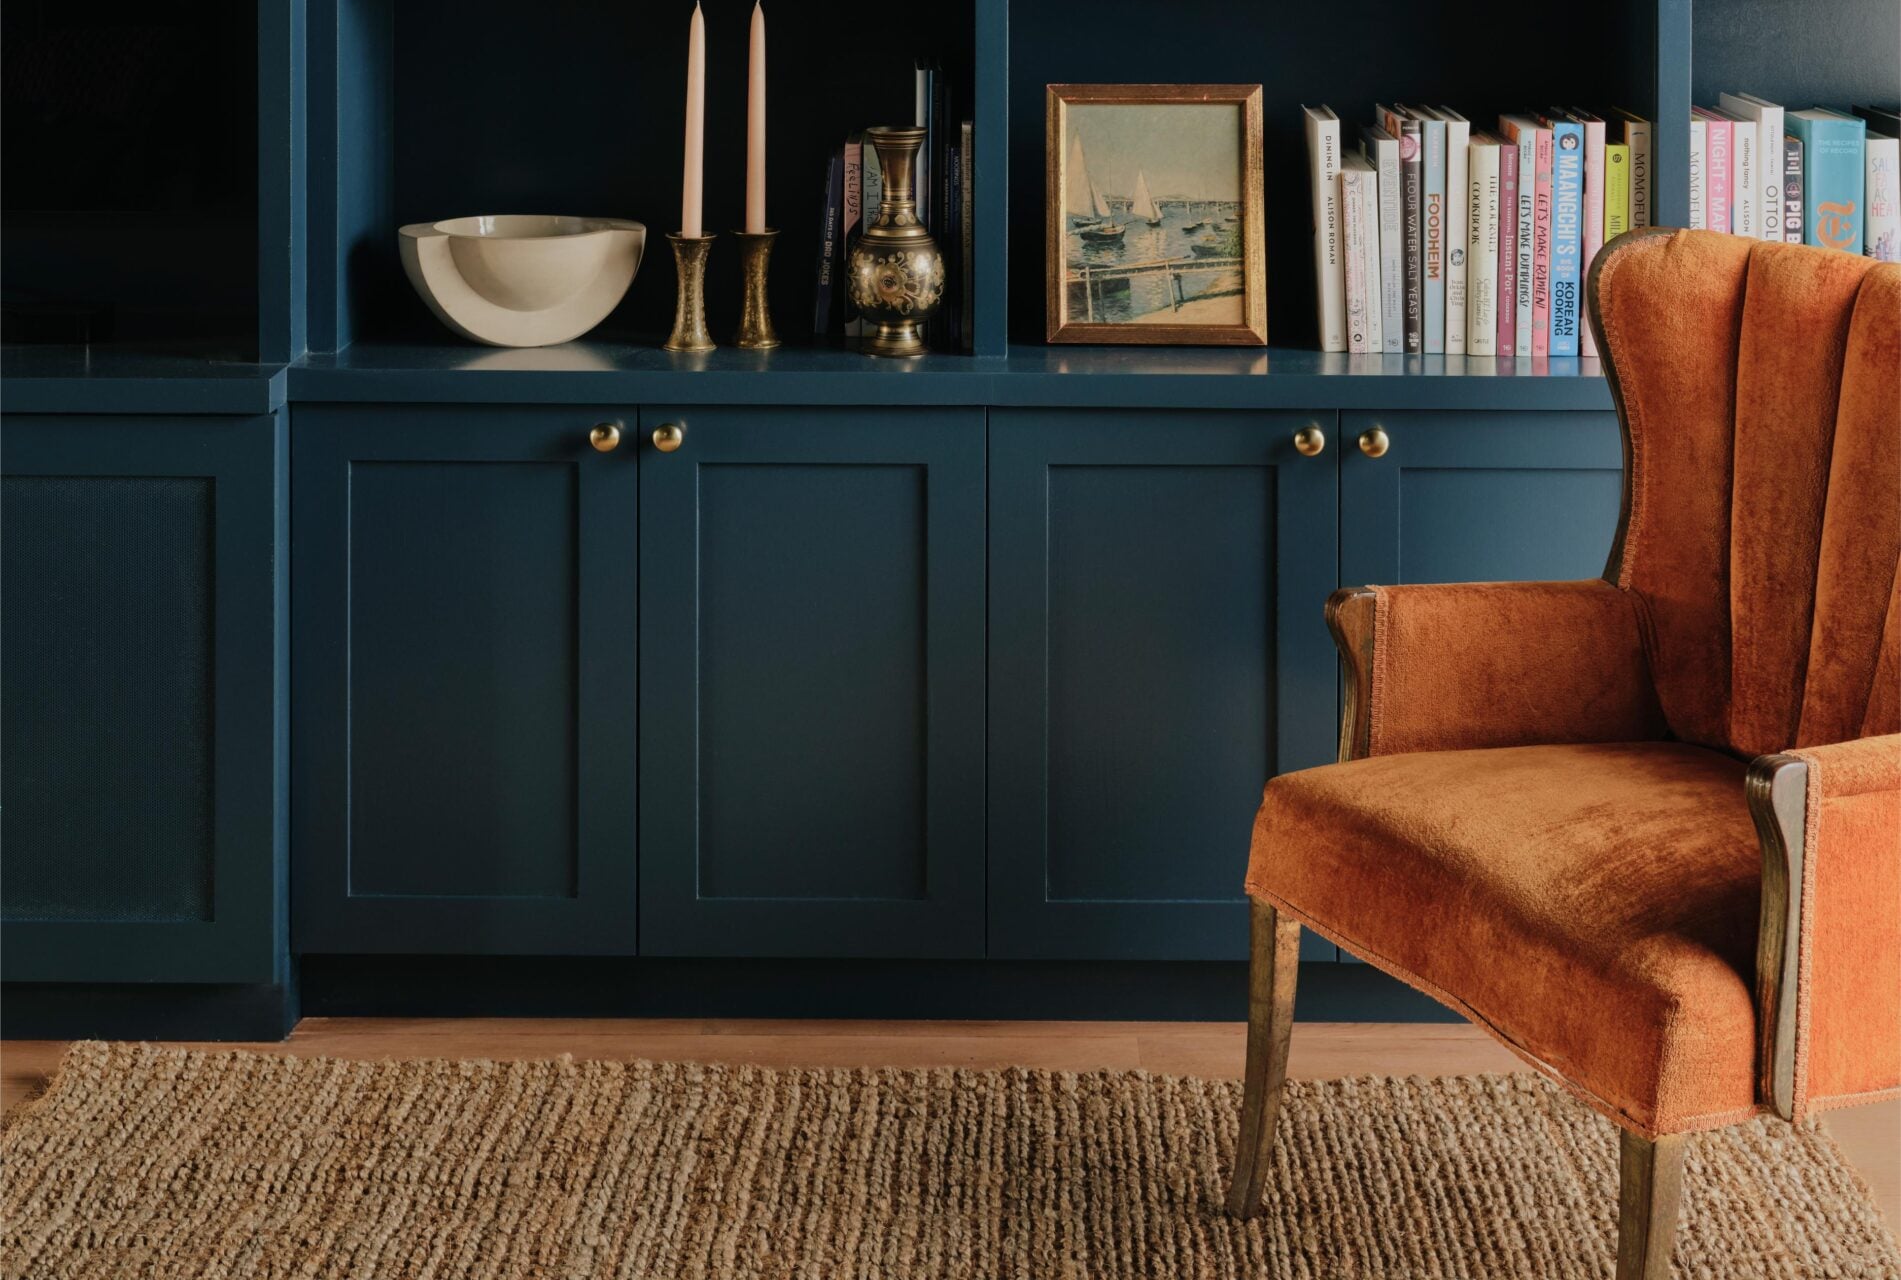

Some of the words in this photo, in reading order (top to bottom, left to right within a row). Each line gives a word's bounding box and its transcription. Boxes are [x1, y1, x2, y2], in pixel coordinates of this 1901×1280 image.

[1407, 173, 1417, 210] FLOUR
[1537, 193, 1549, 222] LET'S
[1556, 155, 1578, 255] MAANGCHI'S
[1407, 214, 1417, 252] WATER
[1786, 201, 1801, 229] PIG
[1427, 193, 1440, 279] FOODHEIM
[1504, 234, 1514, 272] Instant
[1537, 226, 1547, 260] MAKE
[1408, 255, 1417, 281] SALT
[1535, 263, 1547, 309] RAMEN!
[1408, 286, 1418, 321] YEAST
[1554, 281, 1564, 336] COOKING
[1563, 281, 1575, 336] KOREAN
